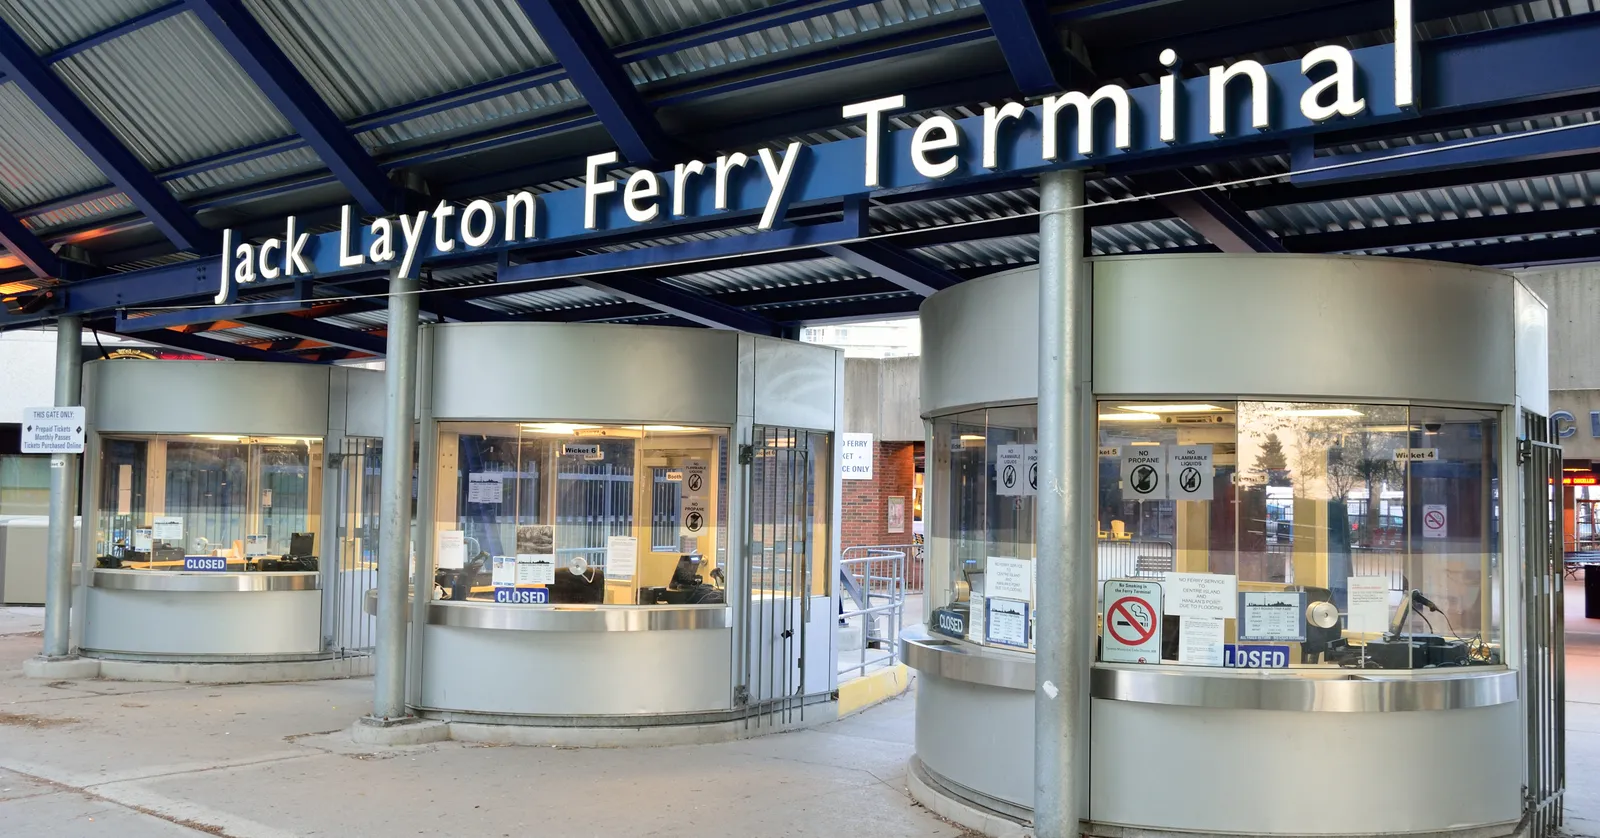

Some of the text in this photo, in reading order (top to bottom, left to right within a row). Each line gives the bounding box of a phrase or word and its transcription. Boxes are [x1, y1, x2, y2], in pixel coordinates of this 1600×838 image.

[215, 0, 1415, 304] Jack Layton Ferry Terminal
[36, 425, 53, 433] Prepaid
[187, 559, 225, 569] CLOSED
[497, 590, 545, 603] CLOSED
[939, 614, 963, 632] CLOSED
[1225, 650, 1285, 668] LOSED
